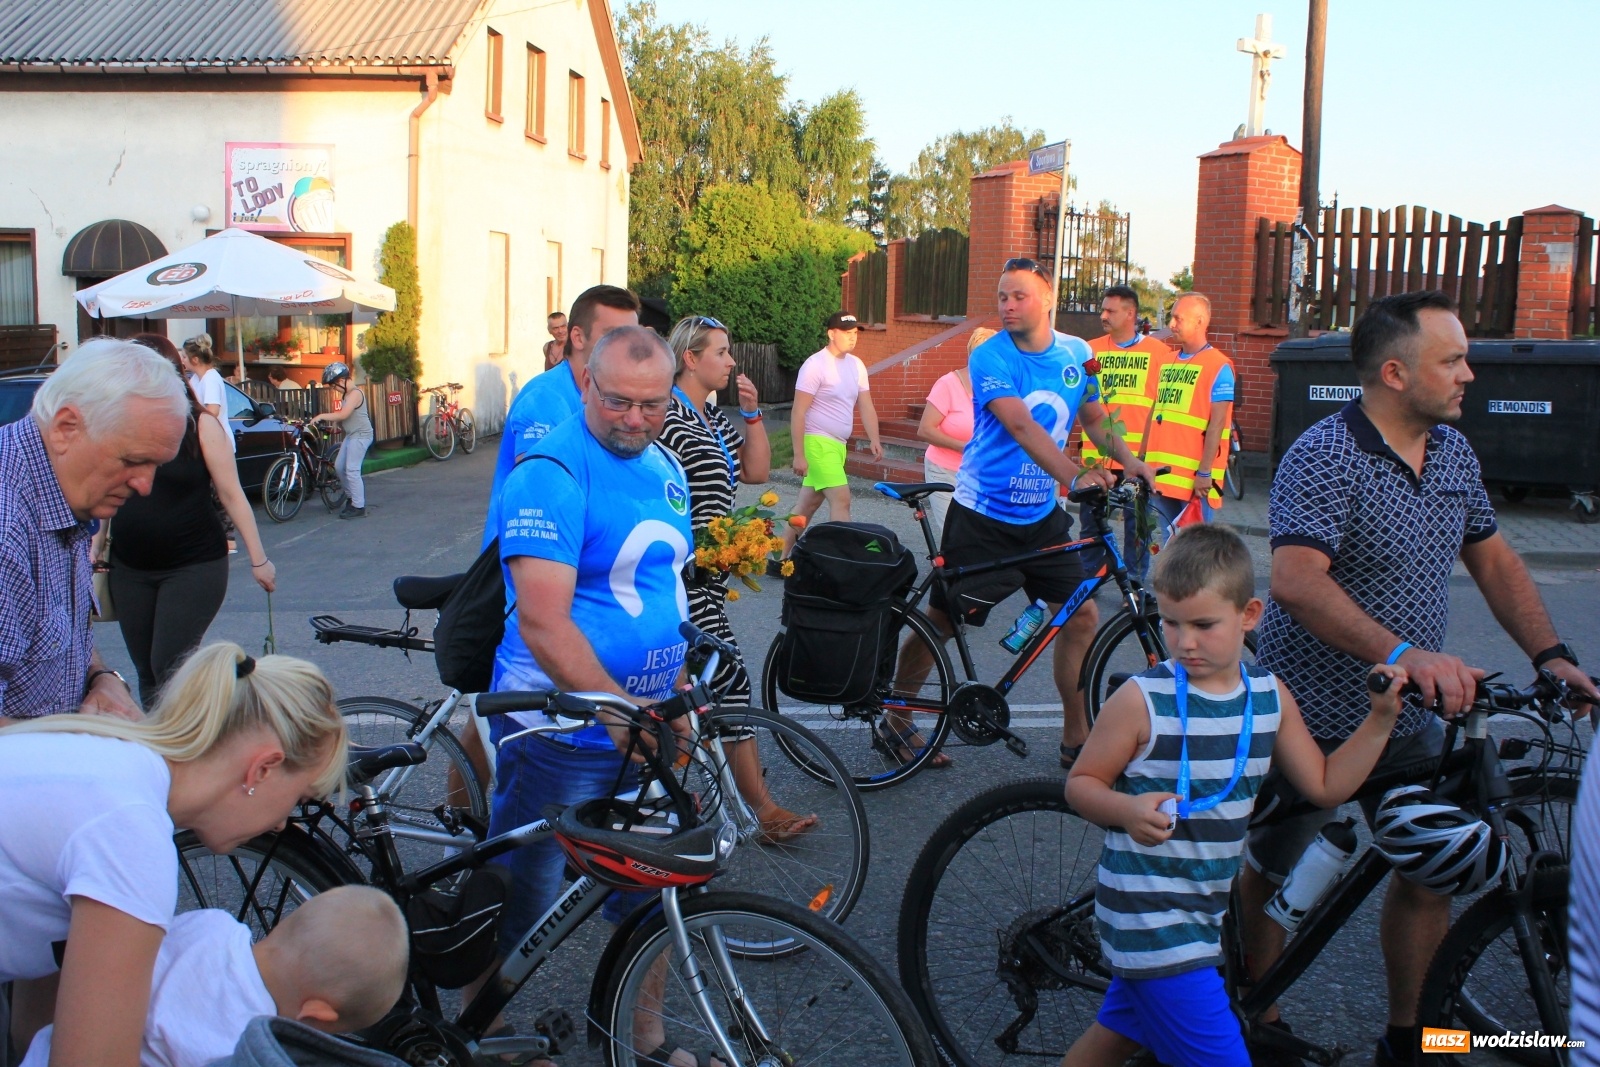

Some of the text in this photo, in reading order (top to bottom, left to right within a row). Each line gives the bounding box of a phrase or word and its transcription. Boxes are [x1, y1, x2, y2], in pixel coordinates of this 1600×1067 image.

[232, 176, 259, 197] TO
[241, 182, 284, 214] LODY
[1159, 368, 1199, 385] IEROWANIE
[1311, 387, 1362, 399] REMOND
[1489, 401, 1547, 413] REMONDIS
[519, 508, 543, 517] MARYJO
[535, 519, 557, 530] POLSKI
[531, 529, 540, 538] ZA
[626, 664, 684, 693] PAMIĘT
[631, 860, 673, 878] LAZER
[519, 889, 585, 958] KETTLER
